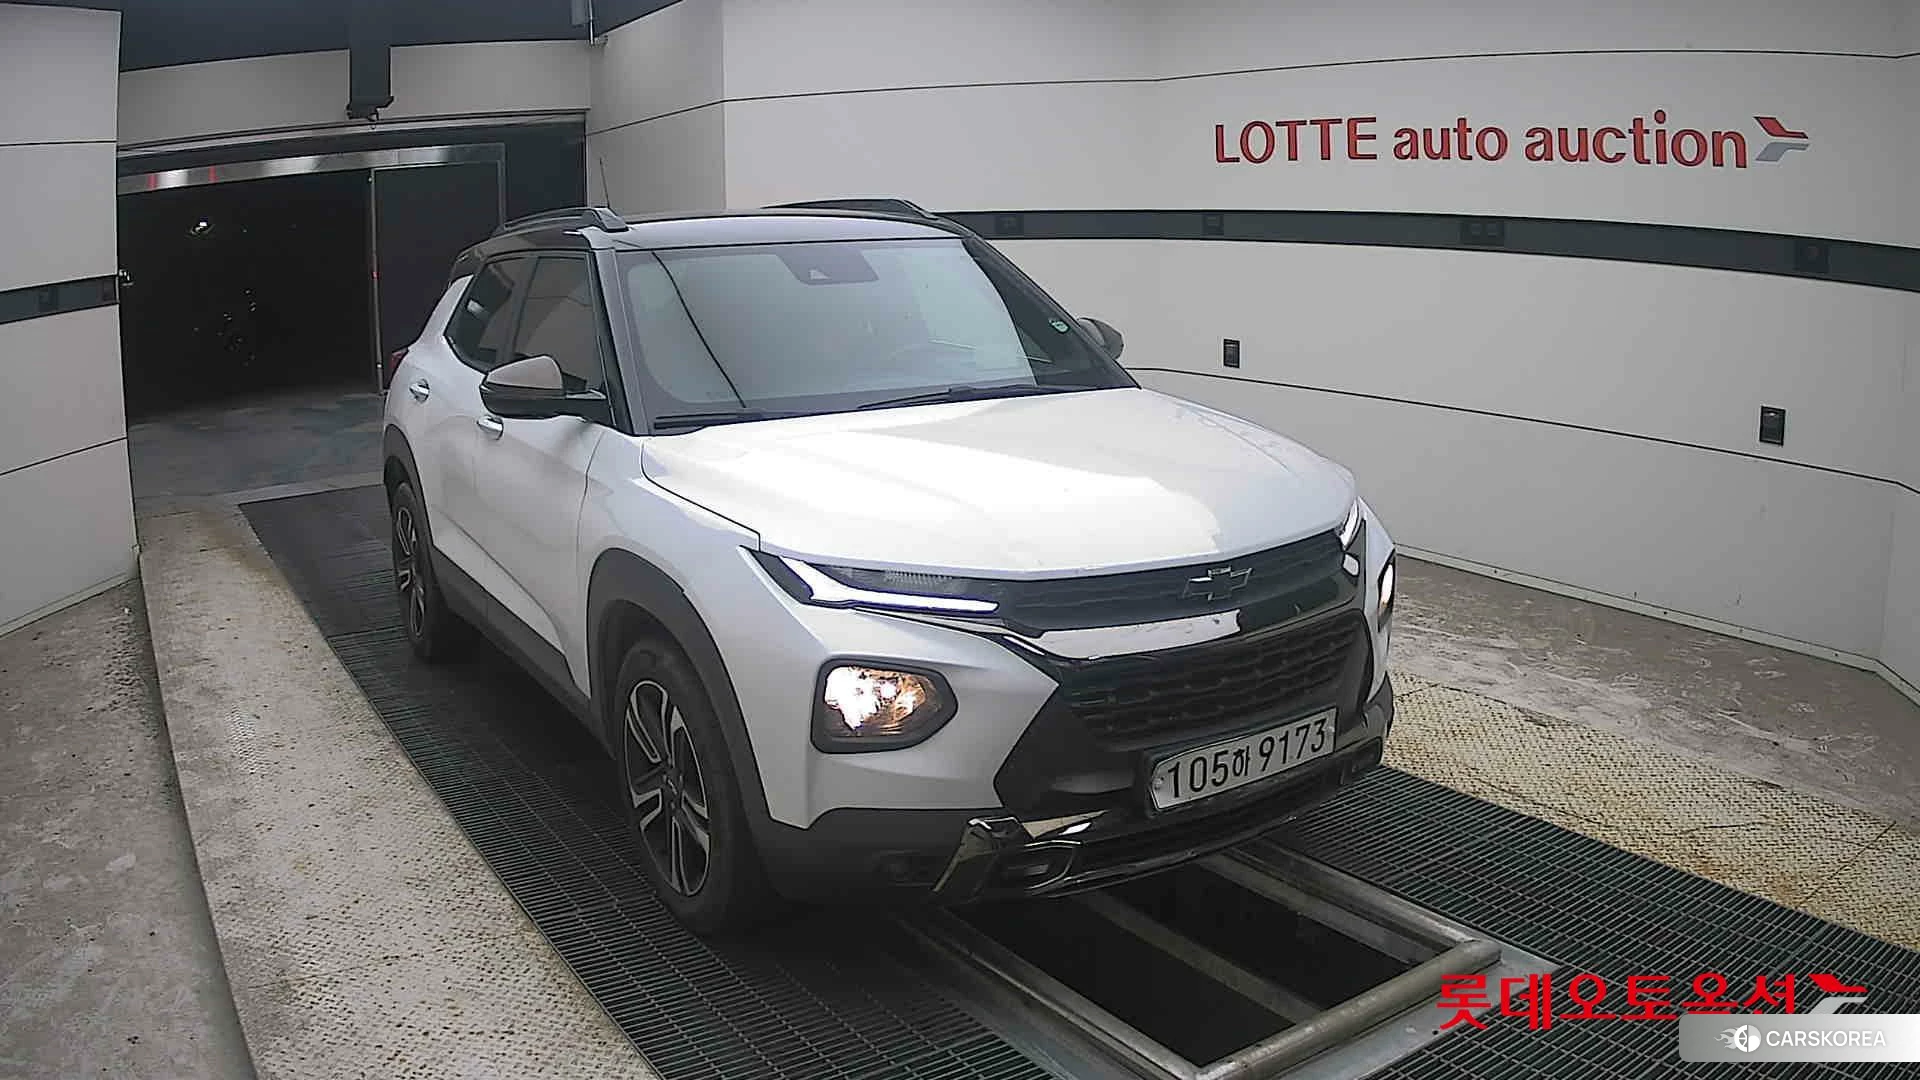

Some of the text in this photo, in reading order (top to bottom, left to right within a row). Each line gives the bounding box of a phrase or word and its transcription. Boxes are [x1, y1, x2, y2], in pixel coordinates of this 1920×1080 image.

[1214, 110, 1749, 168] LOTTE auto auction
[1167, 717, 1328, 799] 105하 9173
